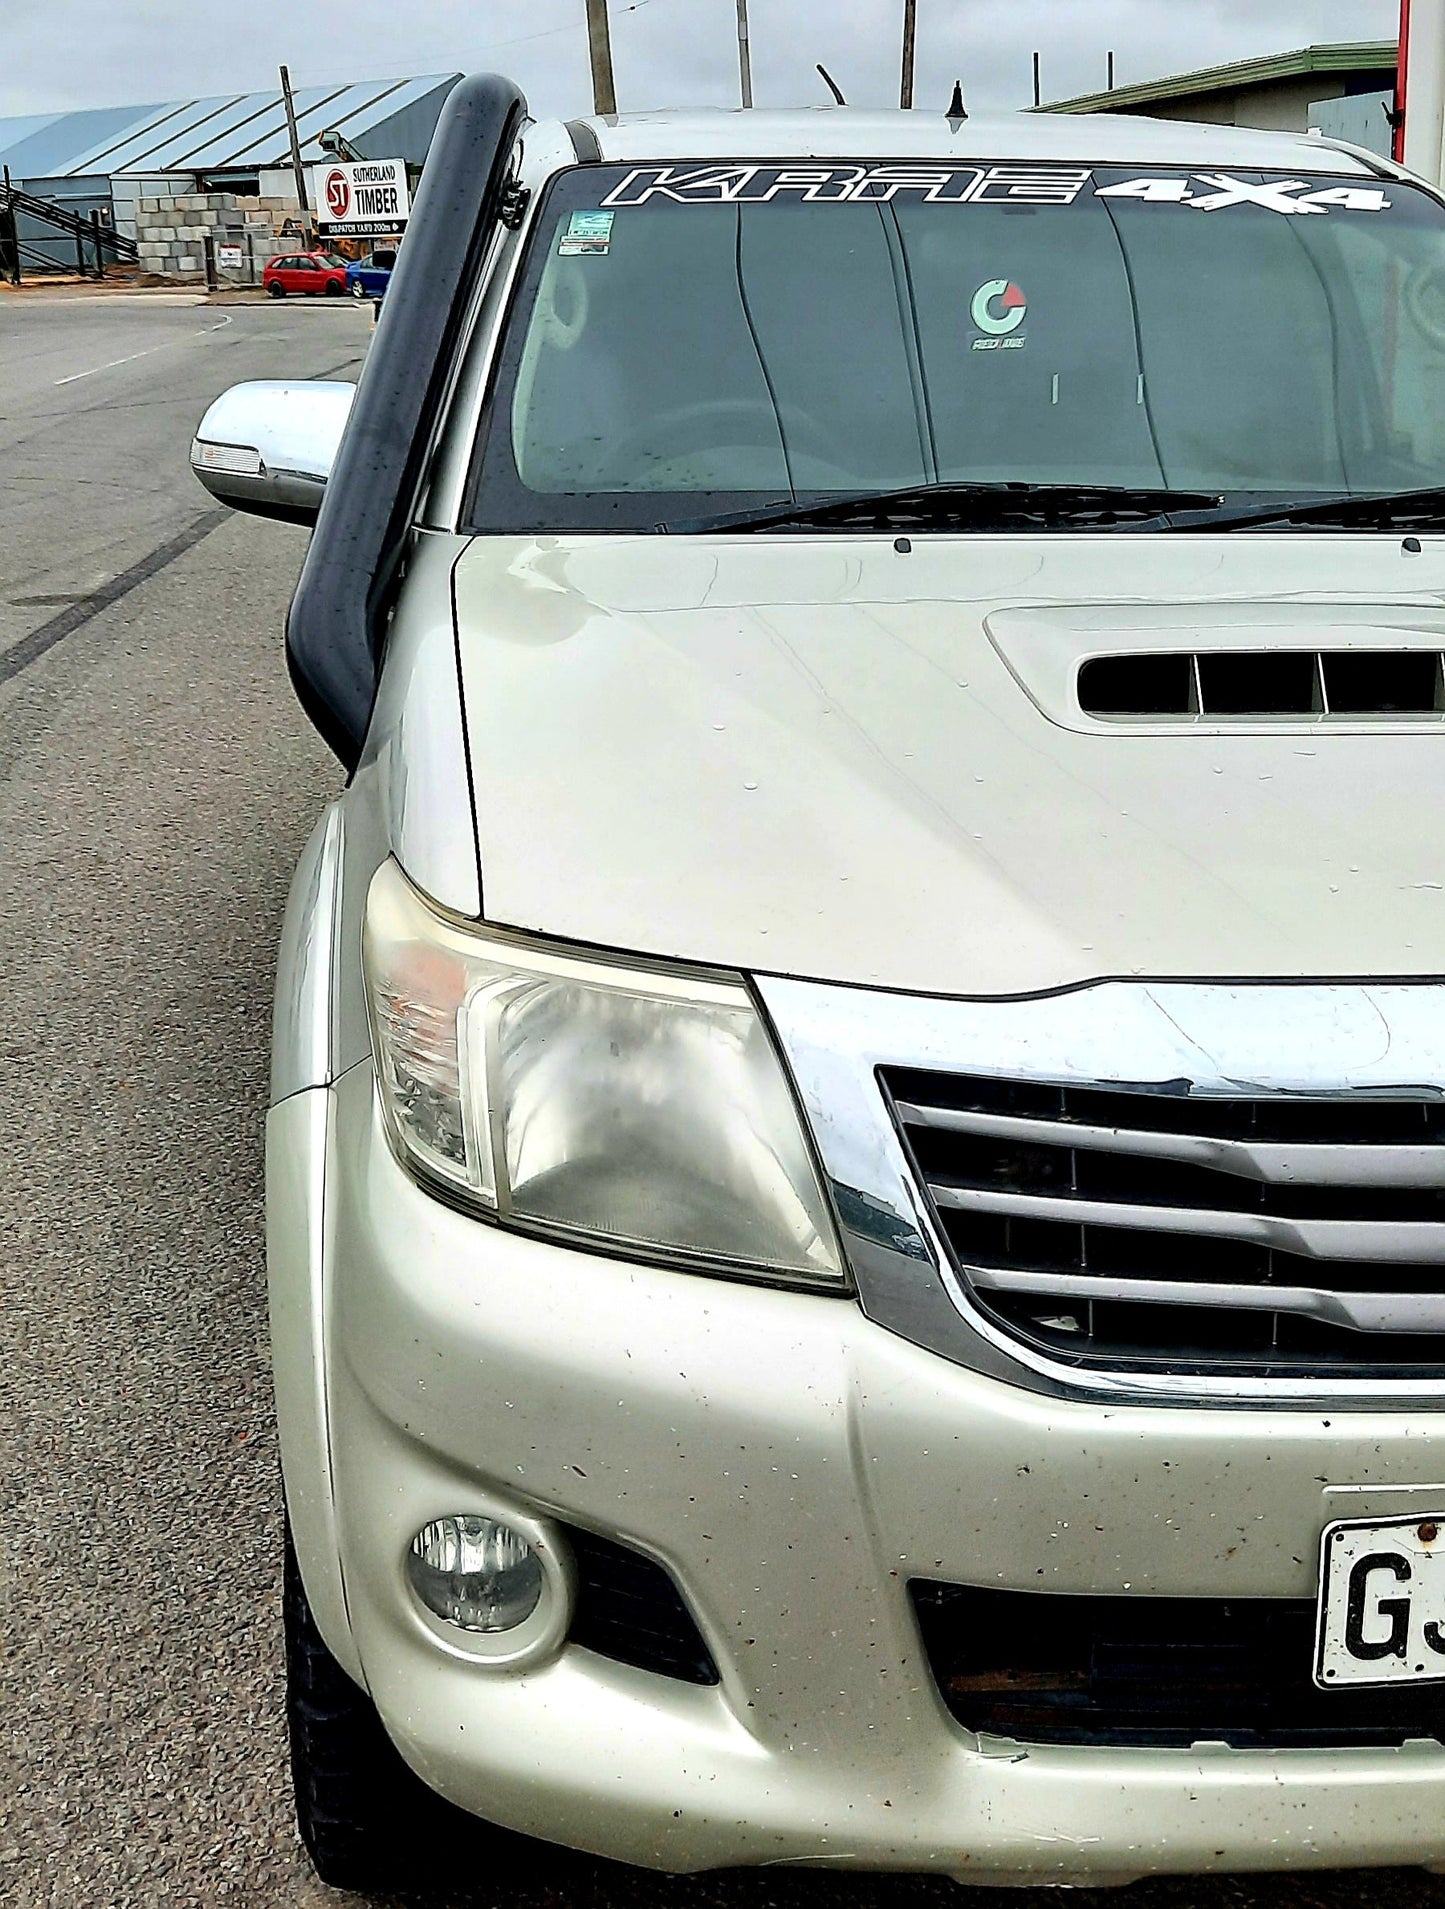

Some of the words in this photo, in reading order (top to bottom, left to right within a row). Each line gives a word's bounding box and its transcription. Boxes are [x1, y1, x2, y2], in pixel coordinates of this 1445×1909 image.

[352, 165, 396, 182] SUTHERLAND
[328, 180, 347, 208] ST
[354, 187, 399, 215] TIMBER
